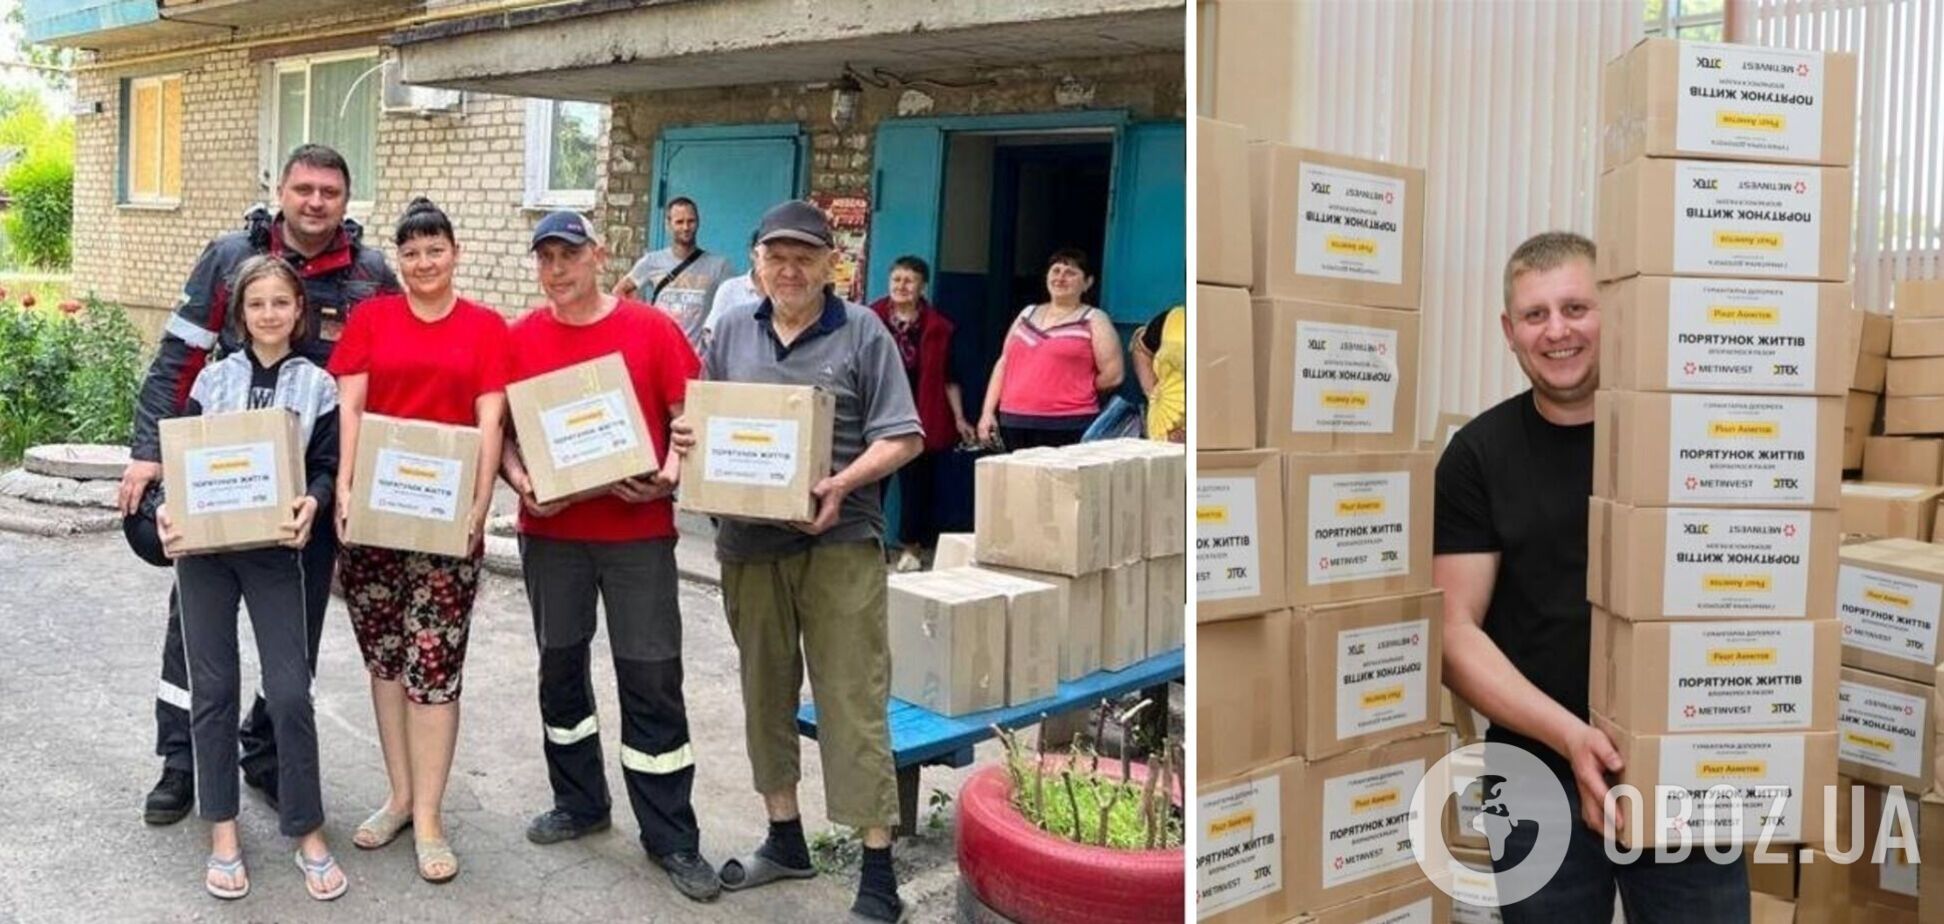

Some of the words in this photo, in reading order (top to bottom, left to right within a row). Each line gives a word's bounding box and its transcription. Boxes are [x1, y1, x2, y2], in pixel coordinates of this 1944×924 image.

[1742, 61, 1794, 73] METINVEST
[1690, 86, 1736, 99] ЖИТТІВ
[1741, 90, 1813, 105] ПОРЯТУНОК
[1738, 181, 1792, 191] METINVEST
[1306, 211, 1343, 225] ЖИТТІВ
[1686, 208, 1733, 219] ЖИТТІВ
[1738, 210, 1811, 222] ПОРЯТУНОК
[1344, 216, 1396, 232] ПОРЯТУНОК
[1678, 333, 1754, 345] ПОРЯТУНОК
[1758, 336, 1805, 346] ЖИТТІВ
[1302, 368, 1338, 379] ЖИТТІВ
[1699, 364, 1753, 373] METINVEST
[1339, 370, 1391, 382] ПОРЯТУНОК
[1680, 449, 1754, 460] ПОРЯТУНОК
[1758, 451, 1805, 461] ЖИТТІВ
[1700, 479, 1753, 489] METINVEST
[1315, 525, 1369, 539] ПОРЯТУНОК
[1370, 523, 1402, 534] ЖИТТІВ
[1729, 526, 1781, 534] METINVEST
[1213, 536, 1249, 547] ЖИТТІВ
[1677, 553, 1723, 563] ЖИТТІВ
[1728, 554, 1800, 564] ПОРЯТУНОК
[1842, 604, 1893, 621] ПОРЯТУНОК
[1897, 615, 1931, 630] ЖИТТІВ
[1679, 677, 1752, 687] ПОРЯТУНОК
[1756, 675, 1802, 686] ЖИТТІВ
[1699, 706, 1751, 715] METINVEST
[1862, 718, 1916, 737] ПОРЯТУНОК
[1330, 819, 1384, 840] ПОРЯТУНОК
[1242, 834, 1275, 851] ЖИТТІВ
